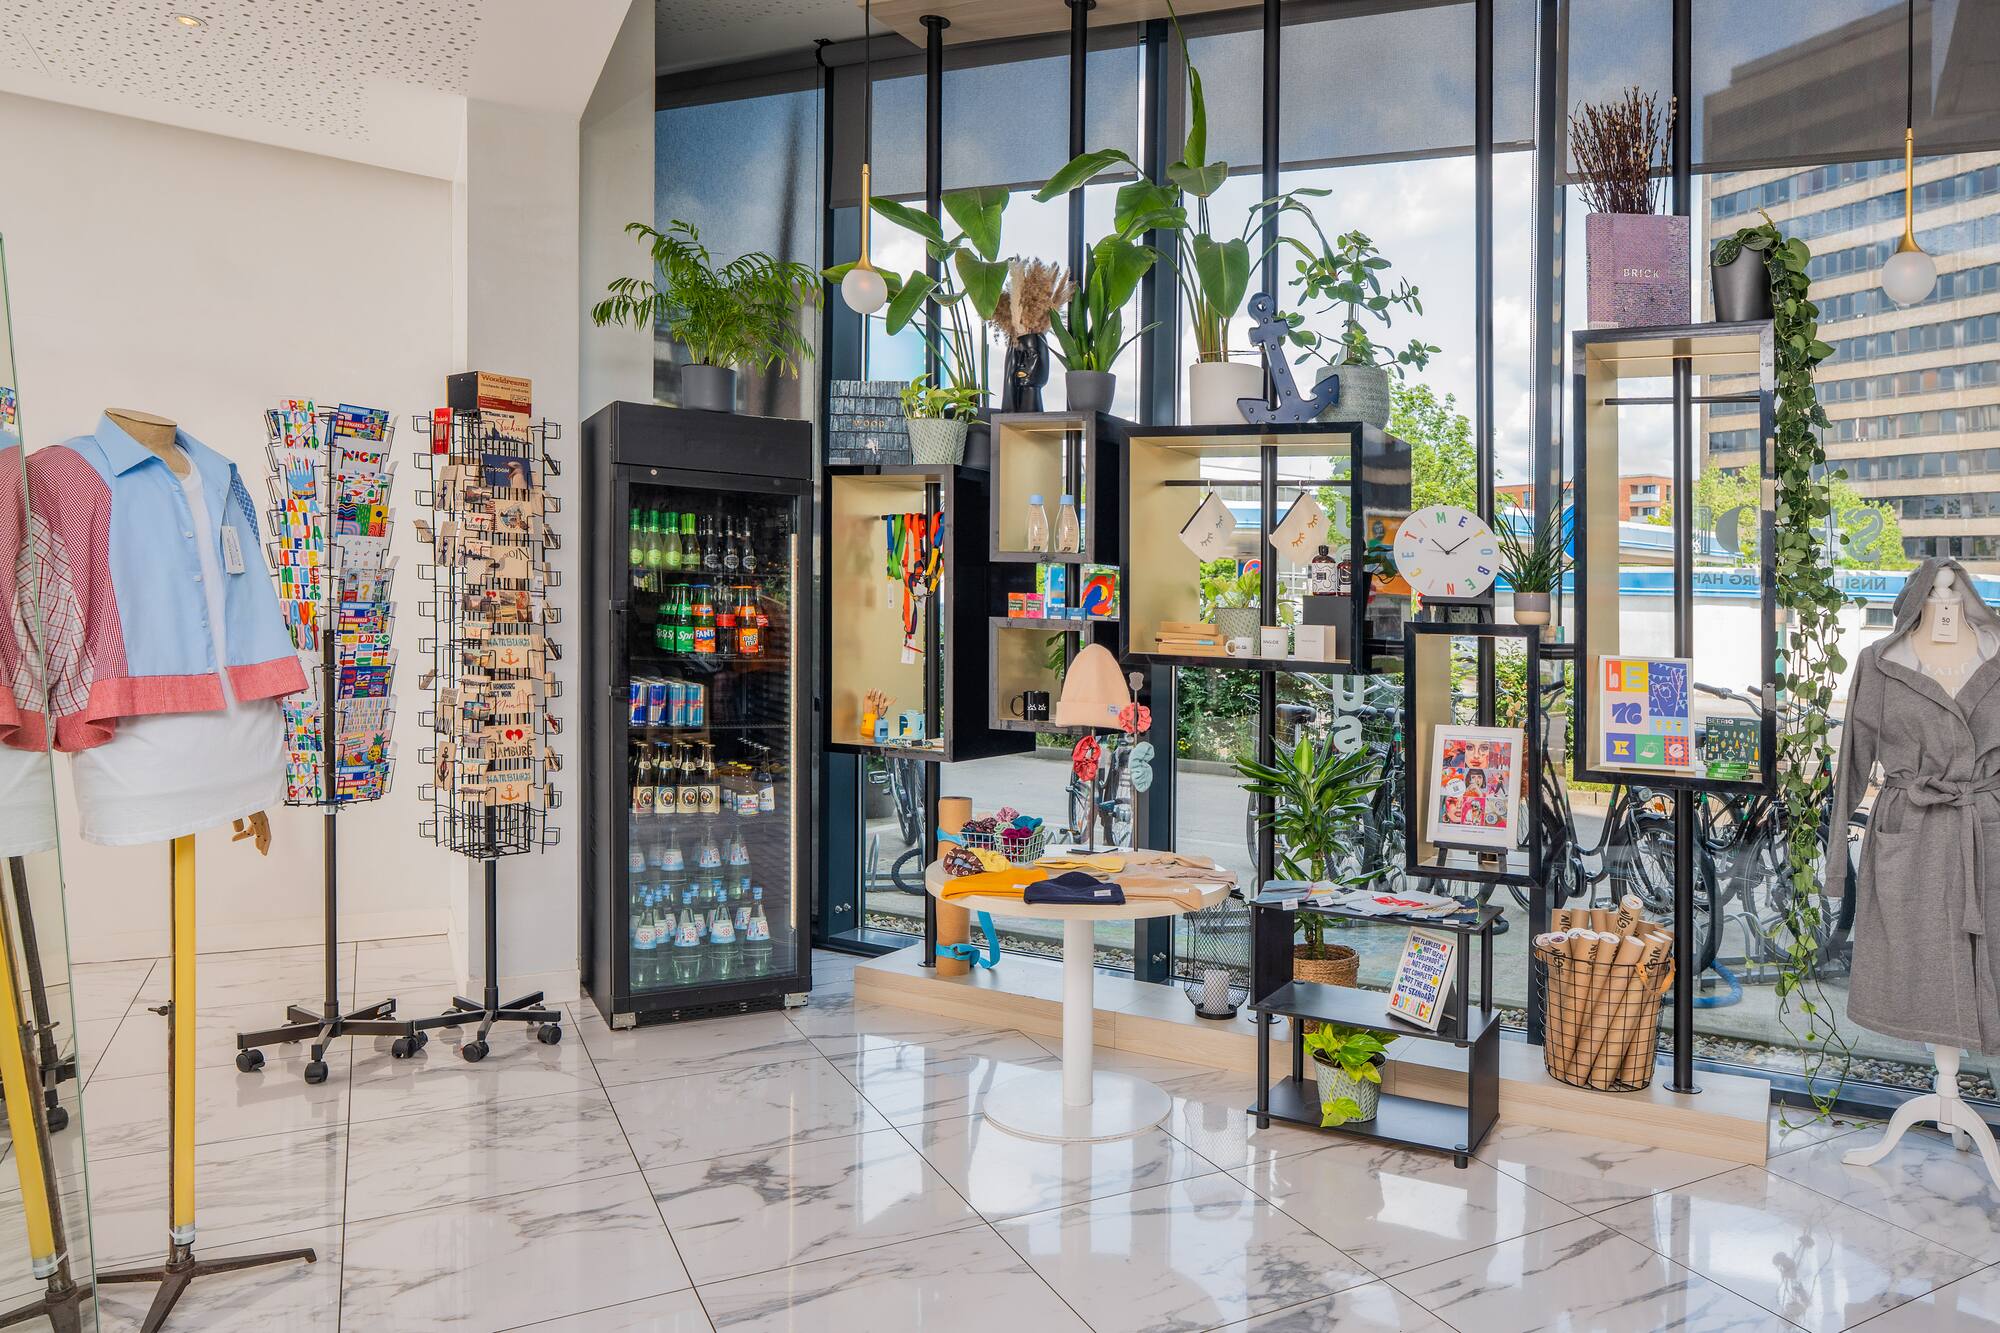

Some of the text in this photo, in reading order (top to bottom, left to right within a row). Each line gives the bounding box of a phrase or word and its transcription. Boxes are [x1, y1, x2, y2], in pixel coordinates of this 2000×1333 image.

[1623, 268, 1660, 278] BRICK
[343, 450, 381, 464] NICE
[280, 499, 320, 513] JAAA
[281, 537, 324, 552] NEIN
[678, 630, 694, 641] Spri
[695, 629, 715, 638] FANT
[490, 745, 533, 758] HAMBURG
[1411, 959, 1442, 976] NOT PERFECT
[1396, 983, 1408, 993] NOT
[1423, 983, 1436, 993] BEST
[1391, 992, 1432, 1020] BUT NICE
